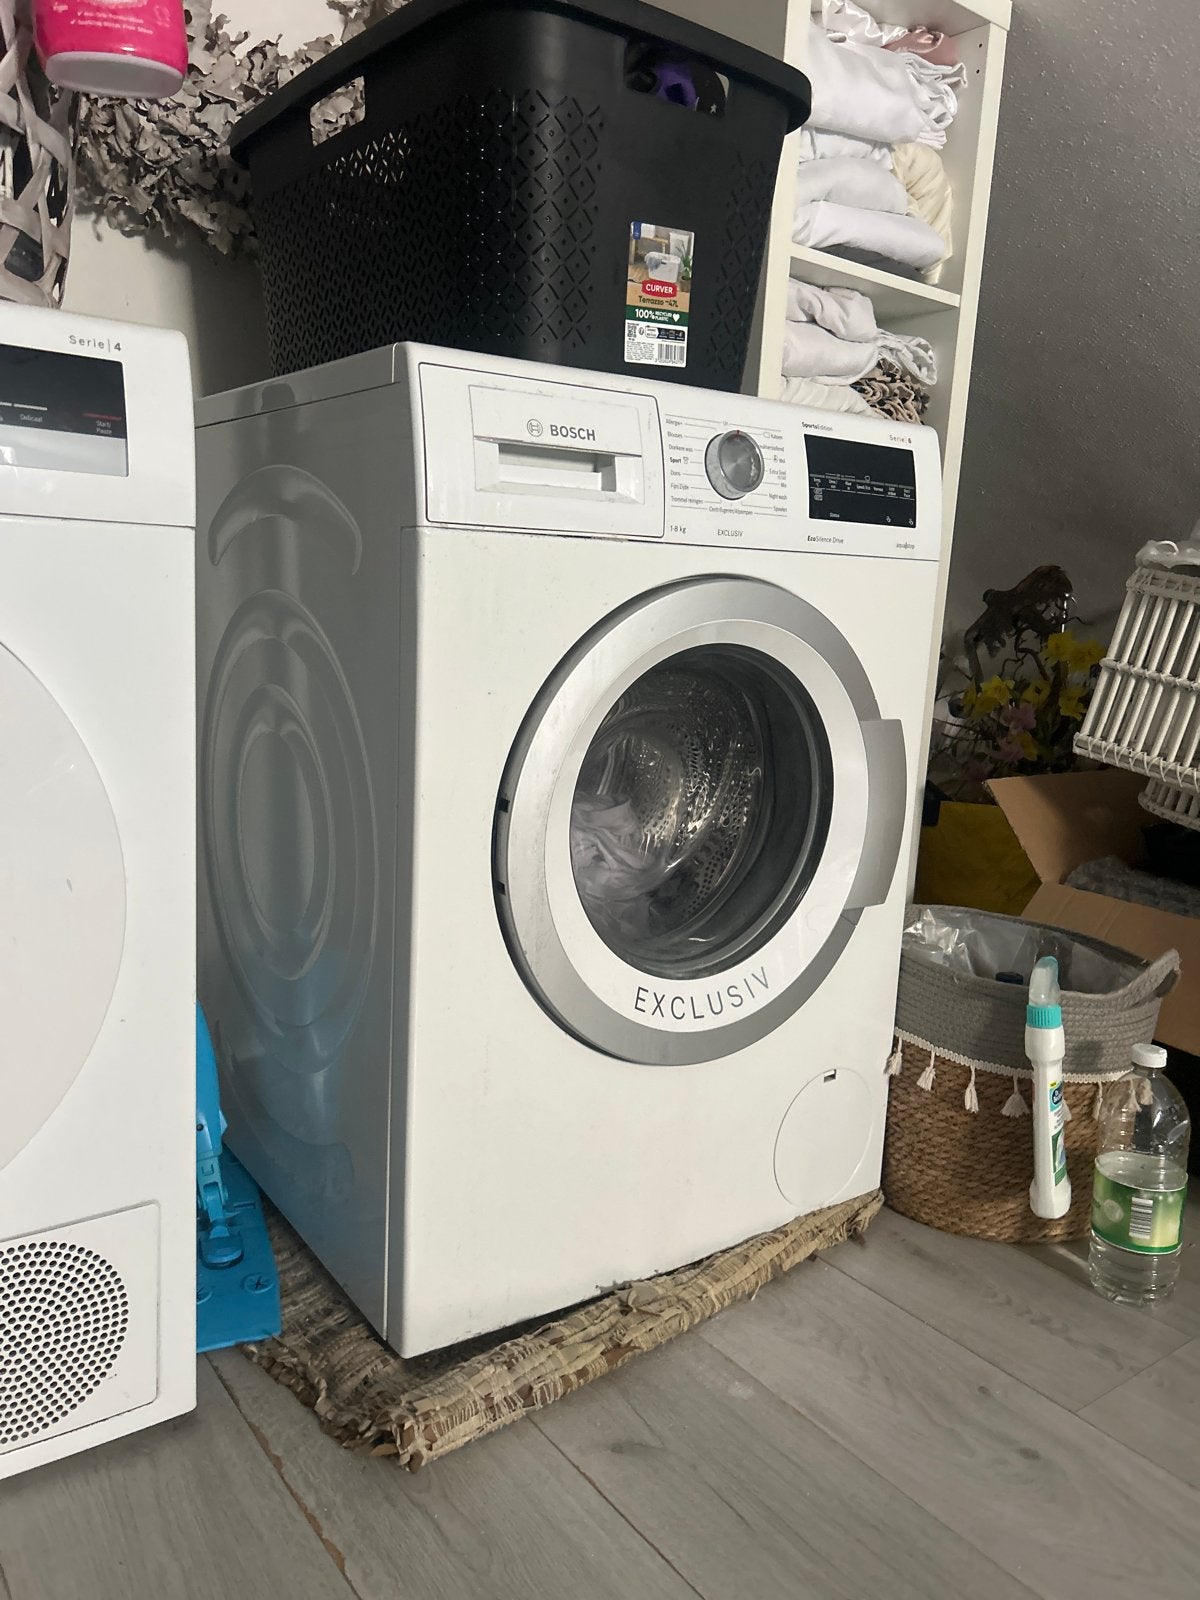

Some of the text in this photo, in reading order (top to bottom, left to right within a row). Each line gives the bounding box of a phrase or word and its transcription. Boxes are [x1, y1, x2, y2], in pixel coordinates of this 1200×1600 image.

[645, 283, 674, 294] CURVER
[638, 295, 664, 306] Terrazzo
[635, 308, 655, 320] 100%
[550, 424, 596, 441] BOSCH
[679, 526, 687, 534] kg
[717, 529, 744, 538] EXCLUSIV
[634, 966, 769, 1020] EXCLUSIV
